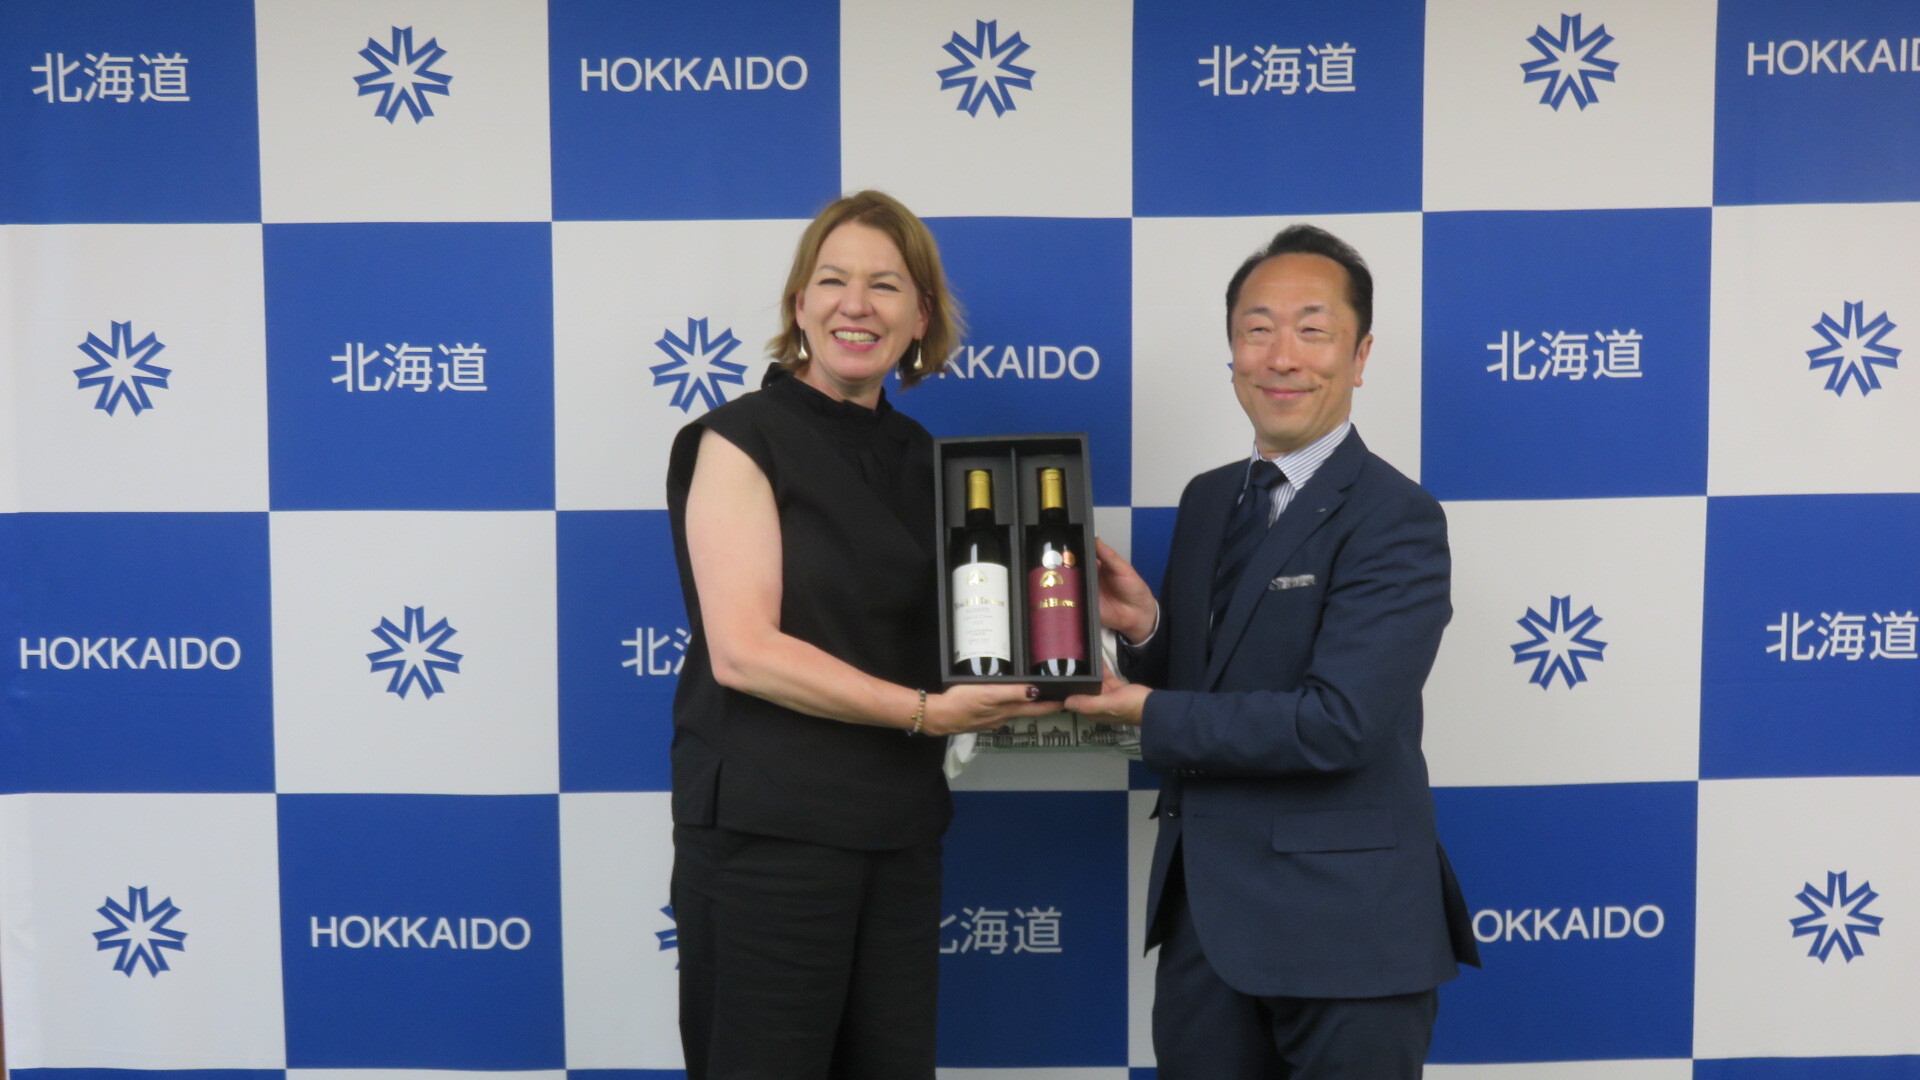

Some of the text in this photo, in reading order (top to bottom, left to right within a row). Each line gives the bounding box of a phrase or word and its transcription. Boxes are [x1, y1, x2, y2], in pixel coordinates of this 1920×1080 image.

[30, 52, 191, 104] 北海道
[580, 55, 809, 93] HOKKAIDO
[1197, 41, 1357, 97] 北海道
[330, 342, 488, 393] 北海道
[1486, 328, 1644, 382] 北海道
[19, 636, 242, 671] HOKKAIDO
[1765, 611, 1919, 662] 北海道
[310, 915, 531, 951] HOKKAIDO
